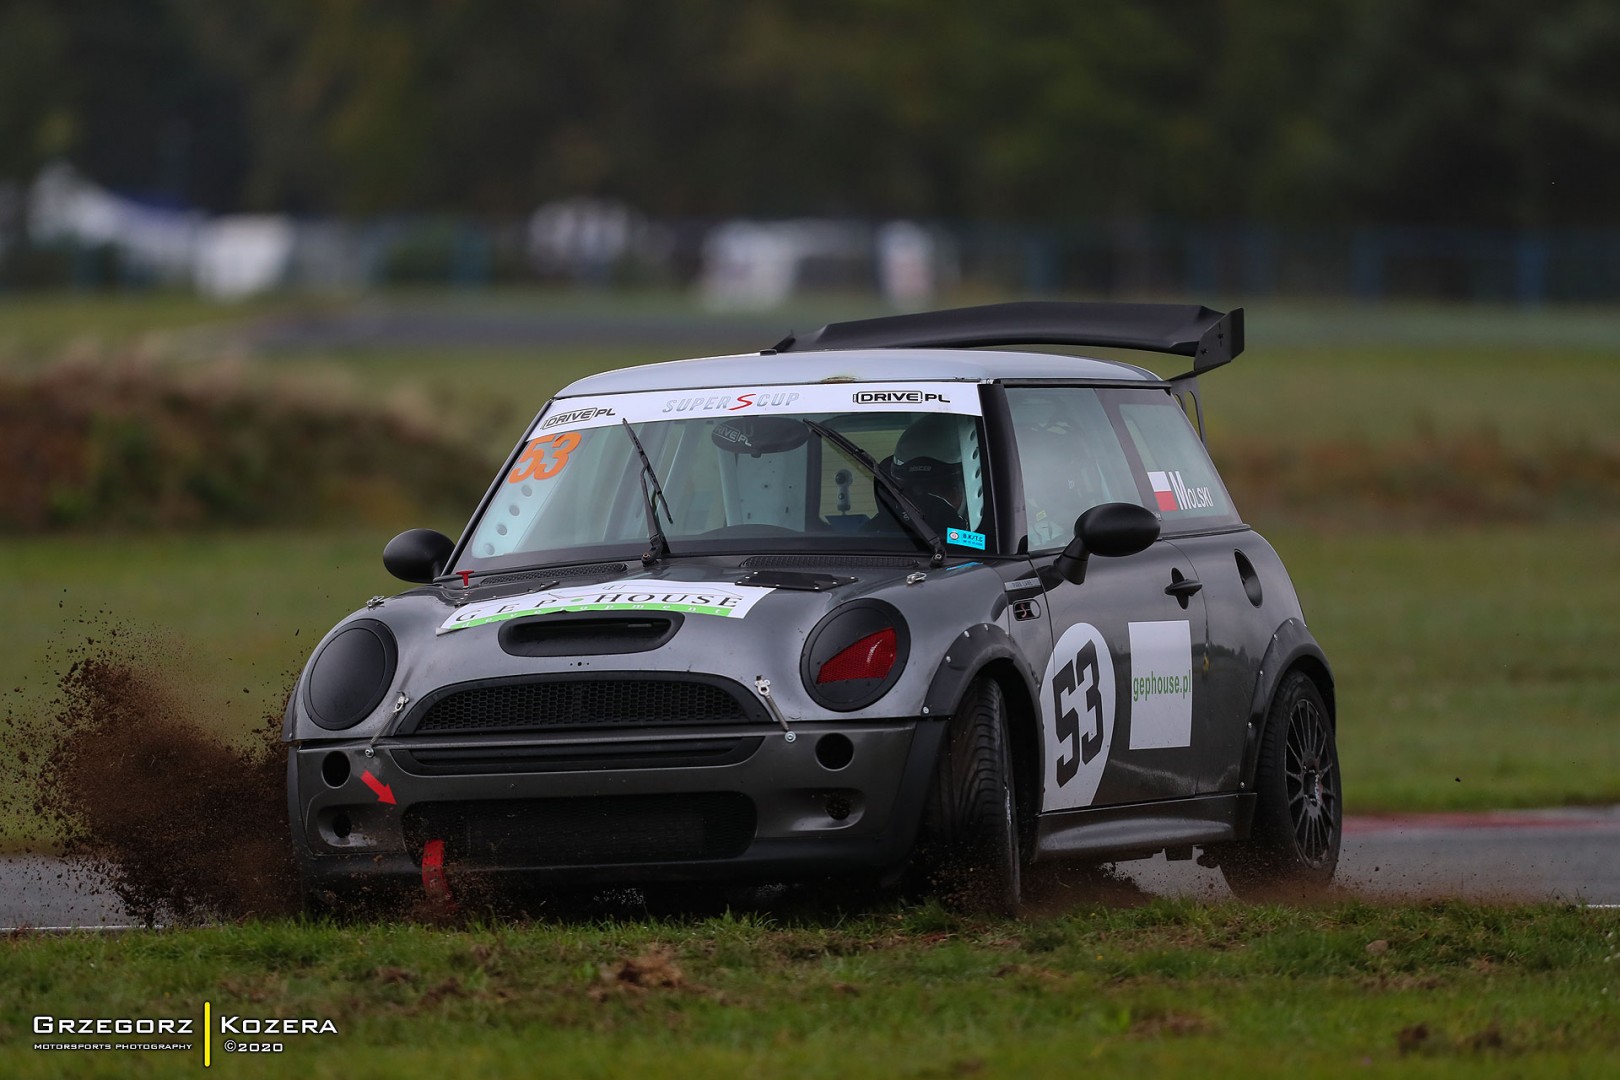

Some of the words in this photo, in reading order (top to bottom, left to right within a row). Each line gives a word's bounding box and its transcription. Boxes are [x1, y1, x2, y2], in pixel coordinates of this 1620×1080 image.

[508, 432, 582, 483] 53
[594, 593, 743, 608] HOUSE
[1133, 670, 1191, 702] gephouse.pl
[1052, 639, 1104, 788] 53
